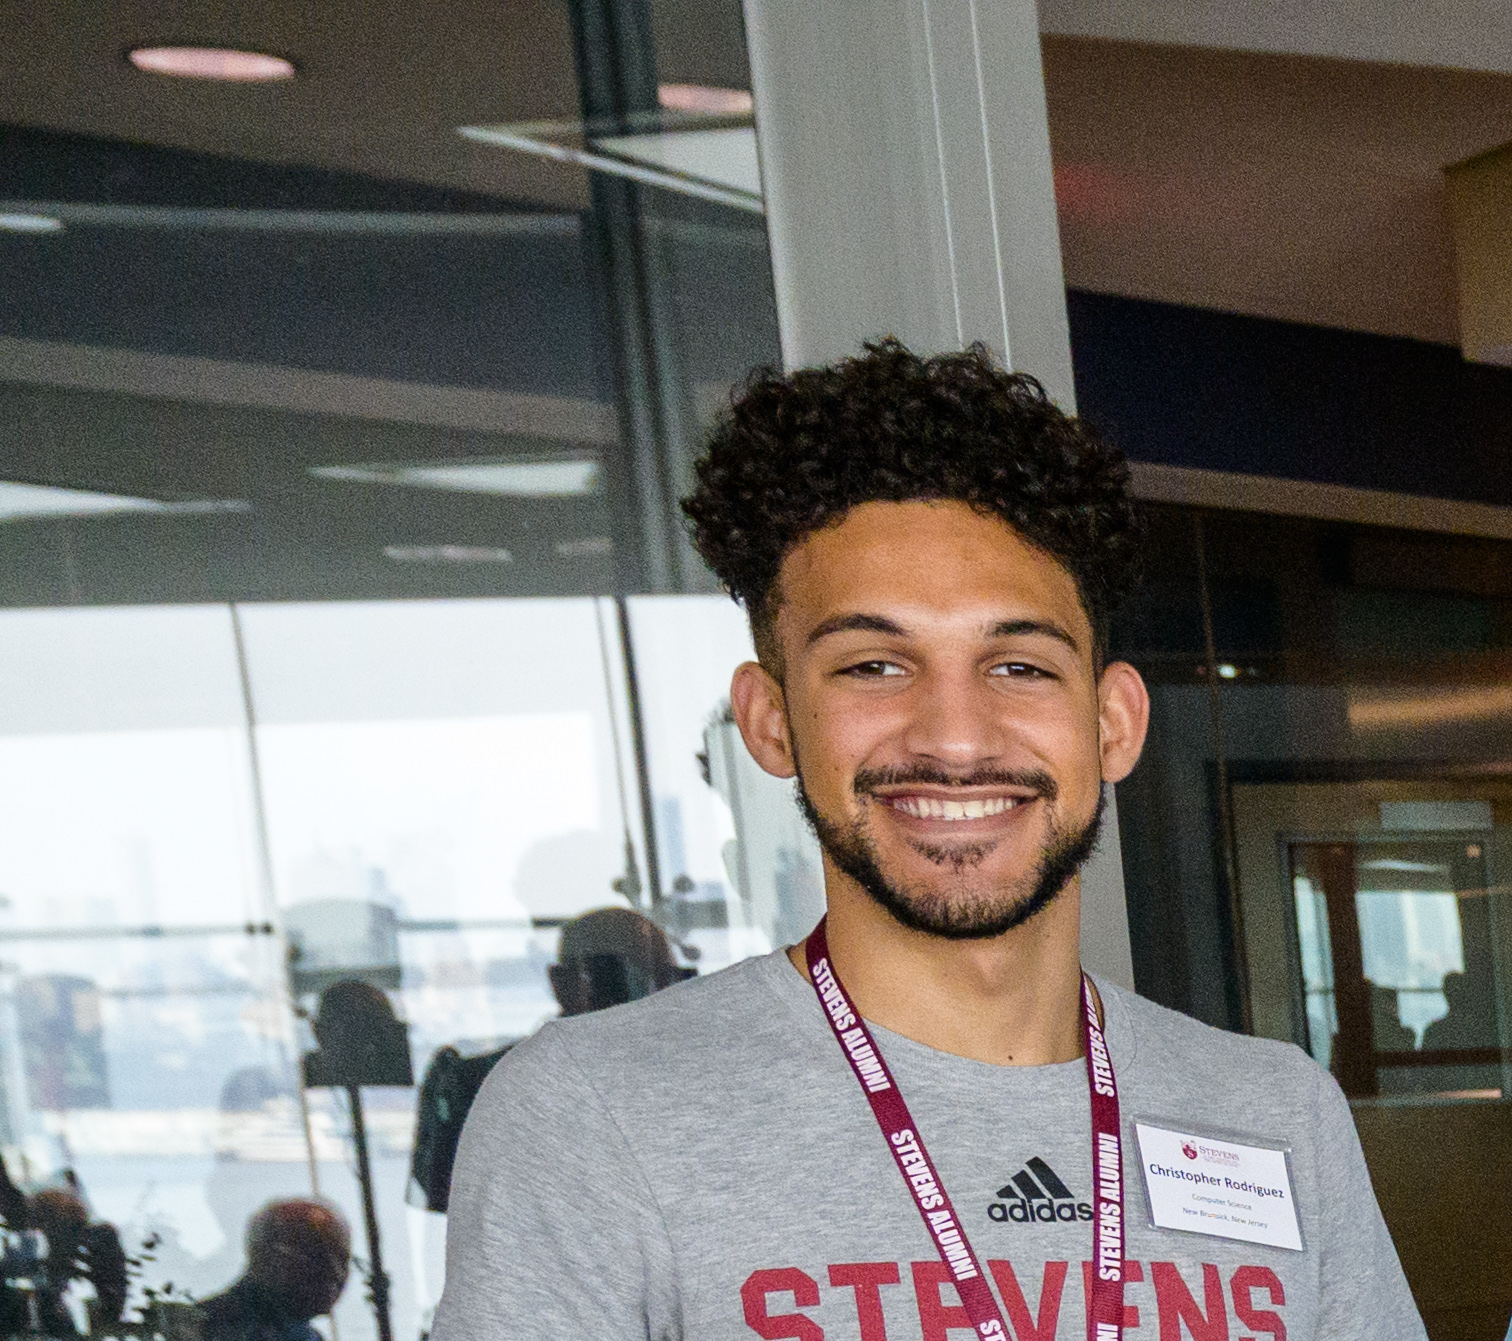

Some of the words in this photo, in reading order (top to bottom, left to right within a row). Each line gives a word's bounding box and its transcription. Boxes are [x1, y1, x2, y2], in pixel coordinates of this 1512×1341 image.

[812, 957, 857, 1031] STEVENS
[842, 1027, 891, 1093] ALUMNI
[1088, 1025, 1115, 1097] STEVENS
[1098, 1132, 1120, 1202] ALUMNI
[1149, 1163, 1222, 1188] Christopher
[1224, 1177, 1285, 1199] Rodriguez
[1199, 1145, 1240, 1161] STEVENS
[891, 1129, 944, 1210] STEVENS
[928, 1209, 978, 1281] ALUMNI
[987, 1199, 1094, 1223] adidas
[1182, 1206, 1198, 1216] New
[1099, 1201, 1121, 1282] STEVENS
